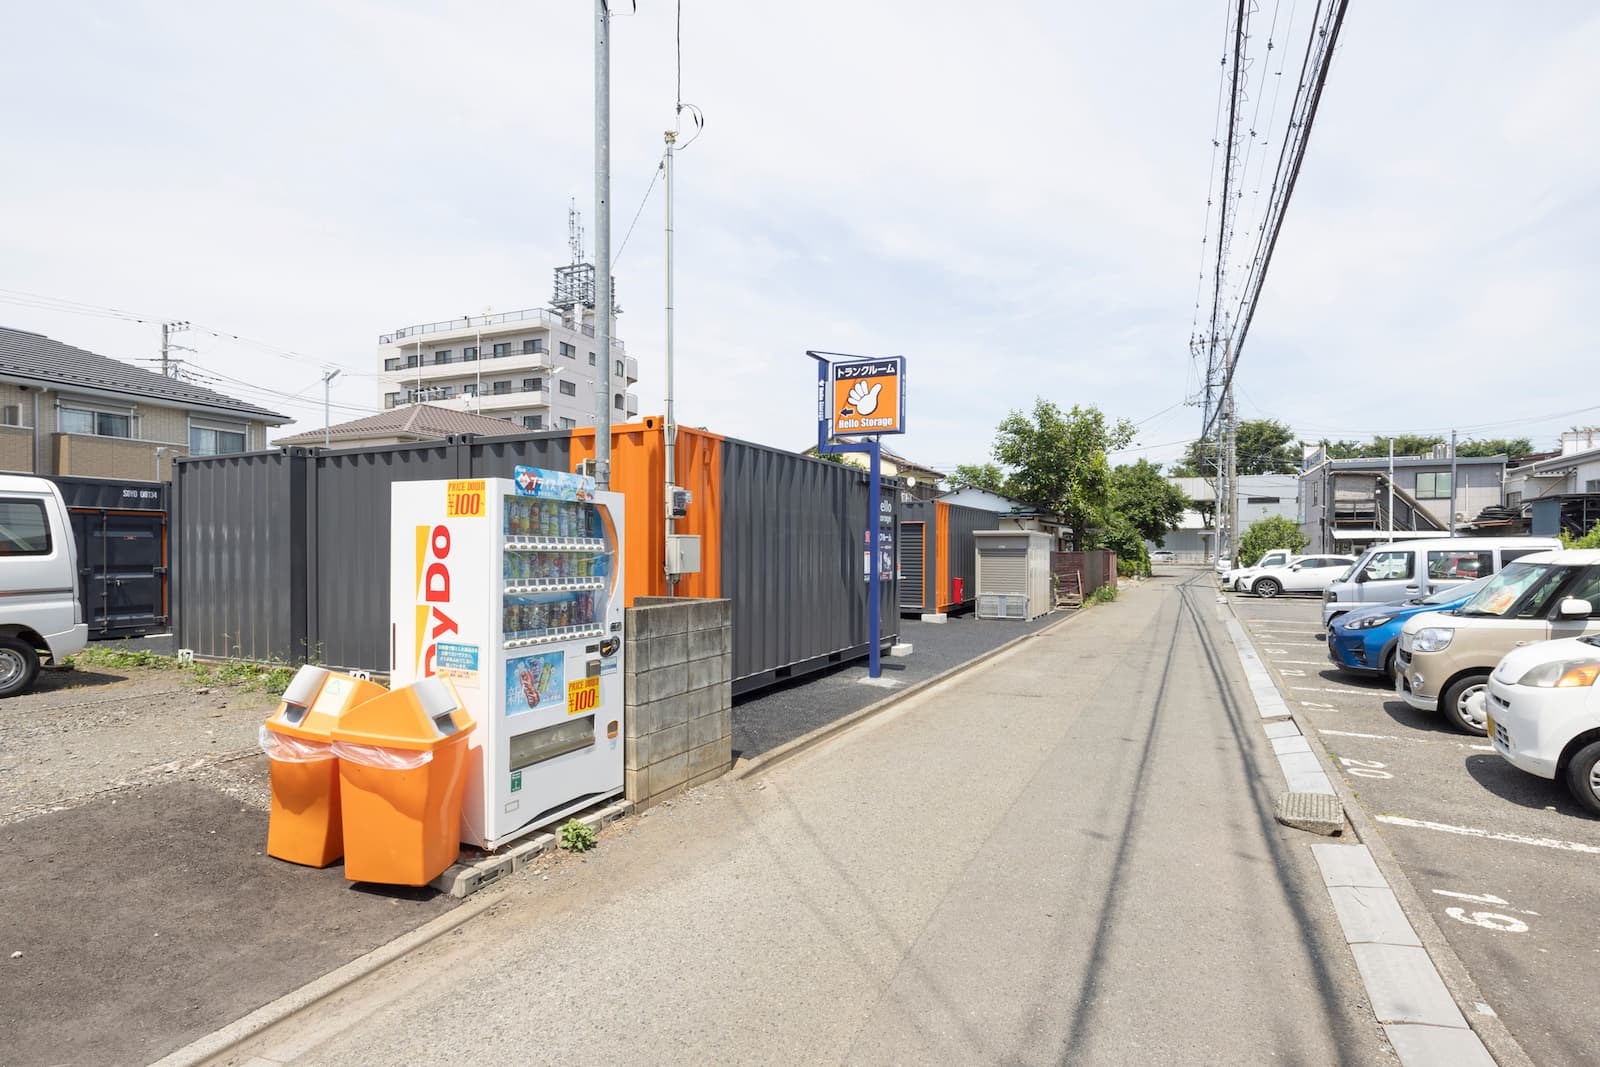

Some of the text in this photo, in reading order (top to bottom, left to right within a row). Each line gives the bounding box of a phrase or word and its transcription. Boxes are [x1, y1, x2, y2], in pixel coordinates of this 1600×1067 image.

[837, 363, 895, 378] トランクルーム
[838, 417, 893, 429] Hello Storage
[447, 480, 485, 491] PRICE DOWN
[568, 680, 585, 692] PRICE
[1339, 757, 1393, 779] 20
